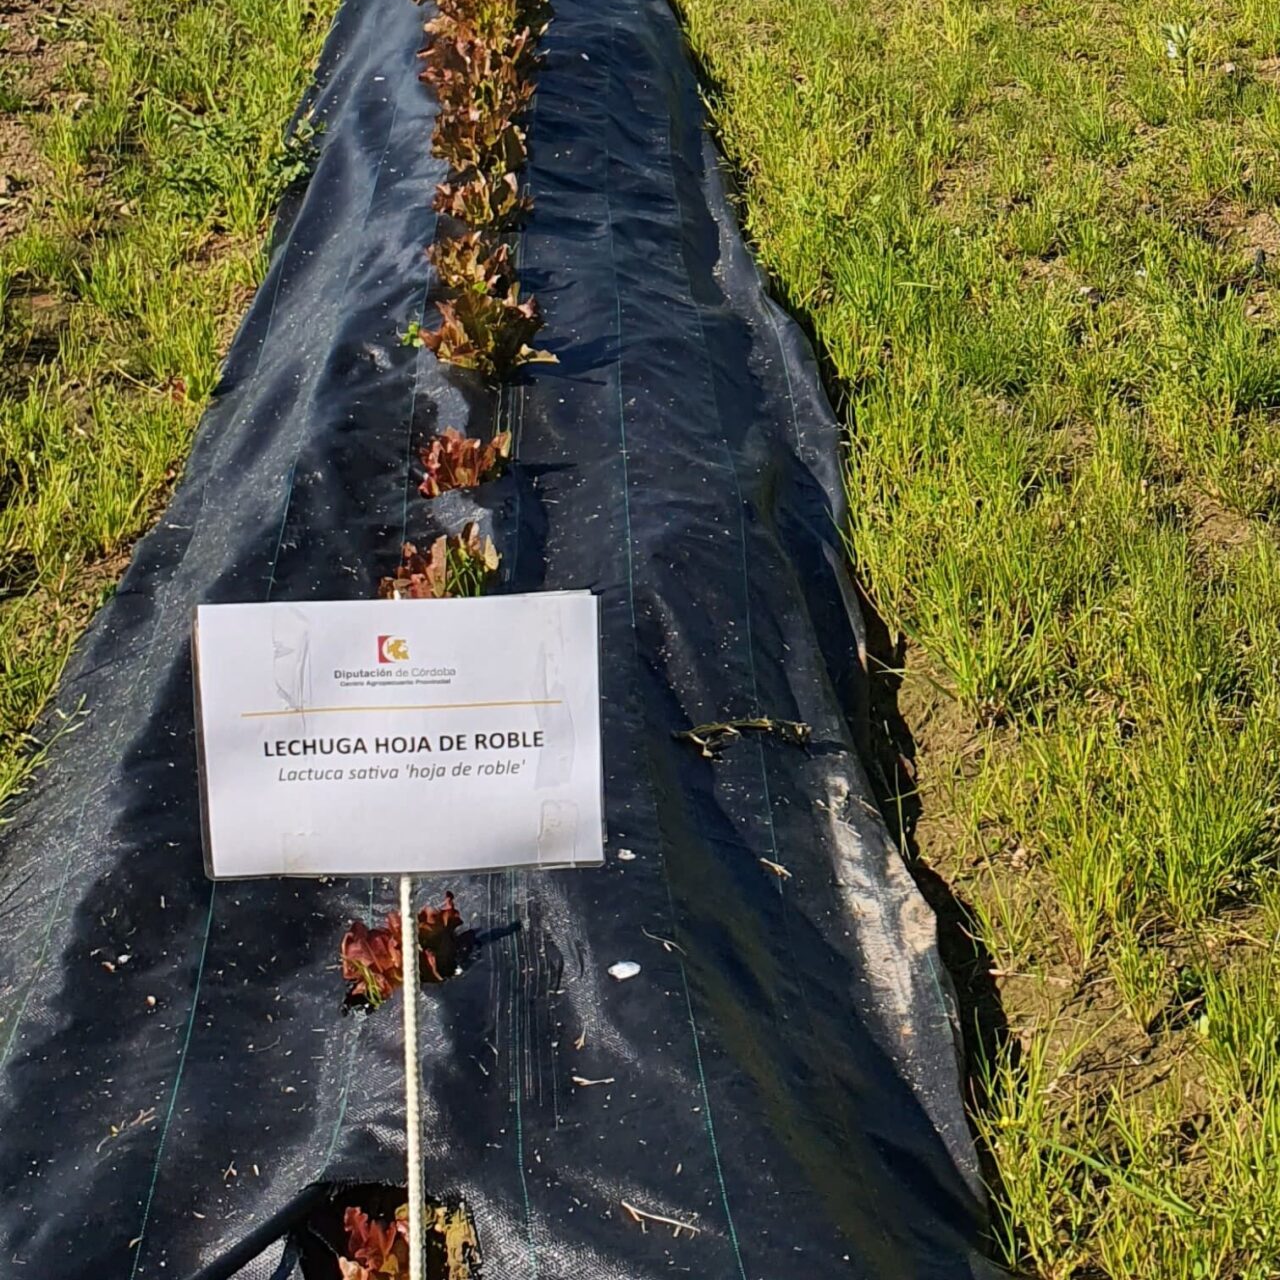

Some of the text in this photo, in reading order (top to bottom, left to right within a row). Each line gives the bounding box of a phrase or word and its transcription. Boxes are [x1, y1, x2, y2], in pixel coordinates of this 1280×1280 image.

[334, 667, 456, 680] Diputación de Córdoba
[264, 730, 545, 757] LECHUGA HOJA DE ROBLE
[279, 759, 526, 782] Lactuca sativa 'hoja de roble'
